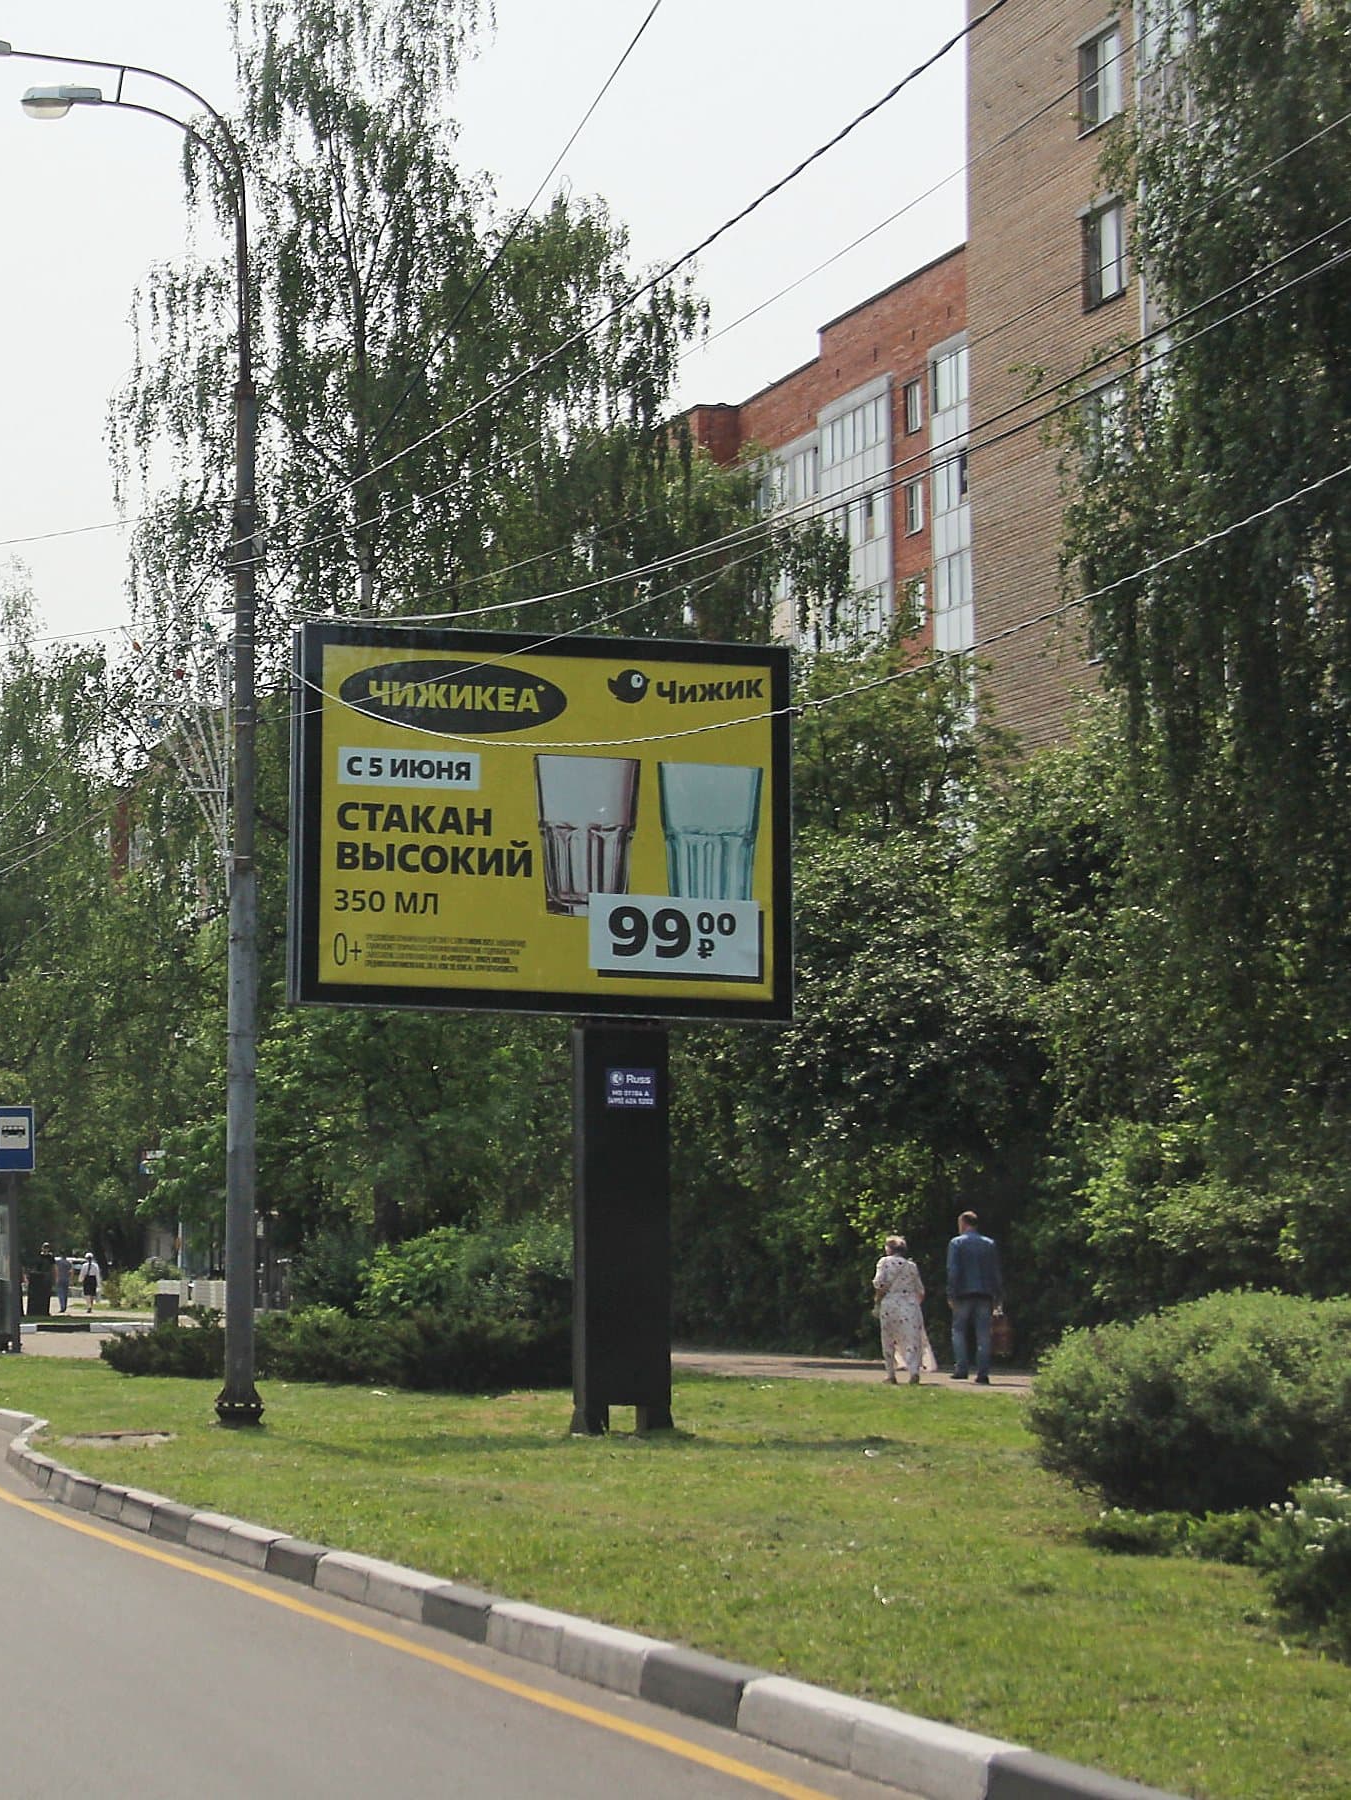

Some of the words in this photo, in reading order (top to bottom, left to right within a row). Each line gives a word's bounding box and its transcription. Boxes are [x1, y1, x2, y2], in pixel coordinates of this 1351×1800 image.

[369, 680, 542, 713] ЧИЖИКЕА
[346, 756, 363, 776] С
[369, 757, 383, 777] 5
[390, 758, 471, 782] ИЮНЯ
[337, 802, 492, 836] СТАКАН
[336, 840, 533, 878] ВЫСОКИЙ
[334, 889, 386, 913] 350
[394, 891, 439, 915] МЛ
[333, 932, 362, 966] 0+
[608, 906, 692, 959] 99
[697, 911, 737, 936] 00
[626, 1074, 651, 1084] Russ
